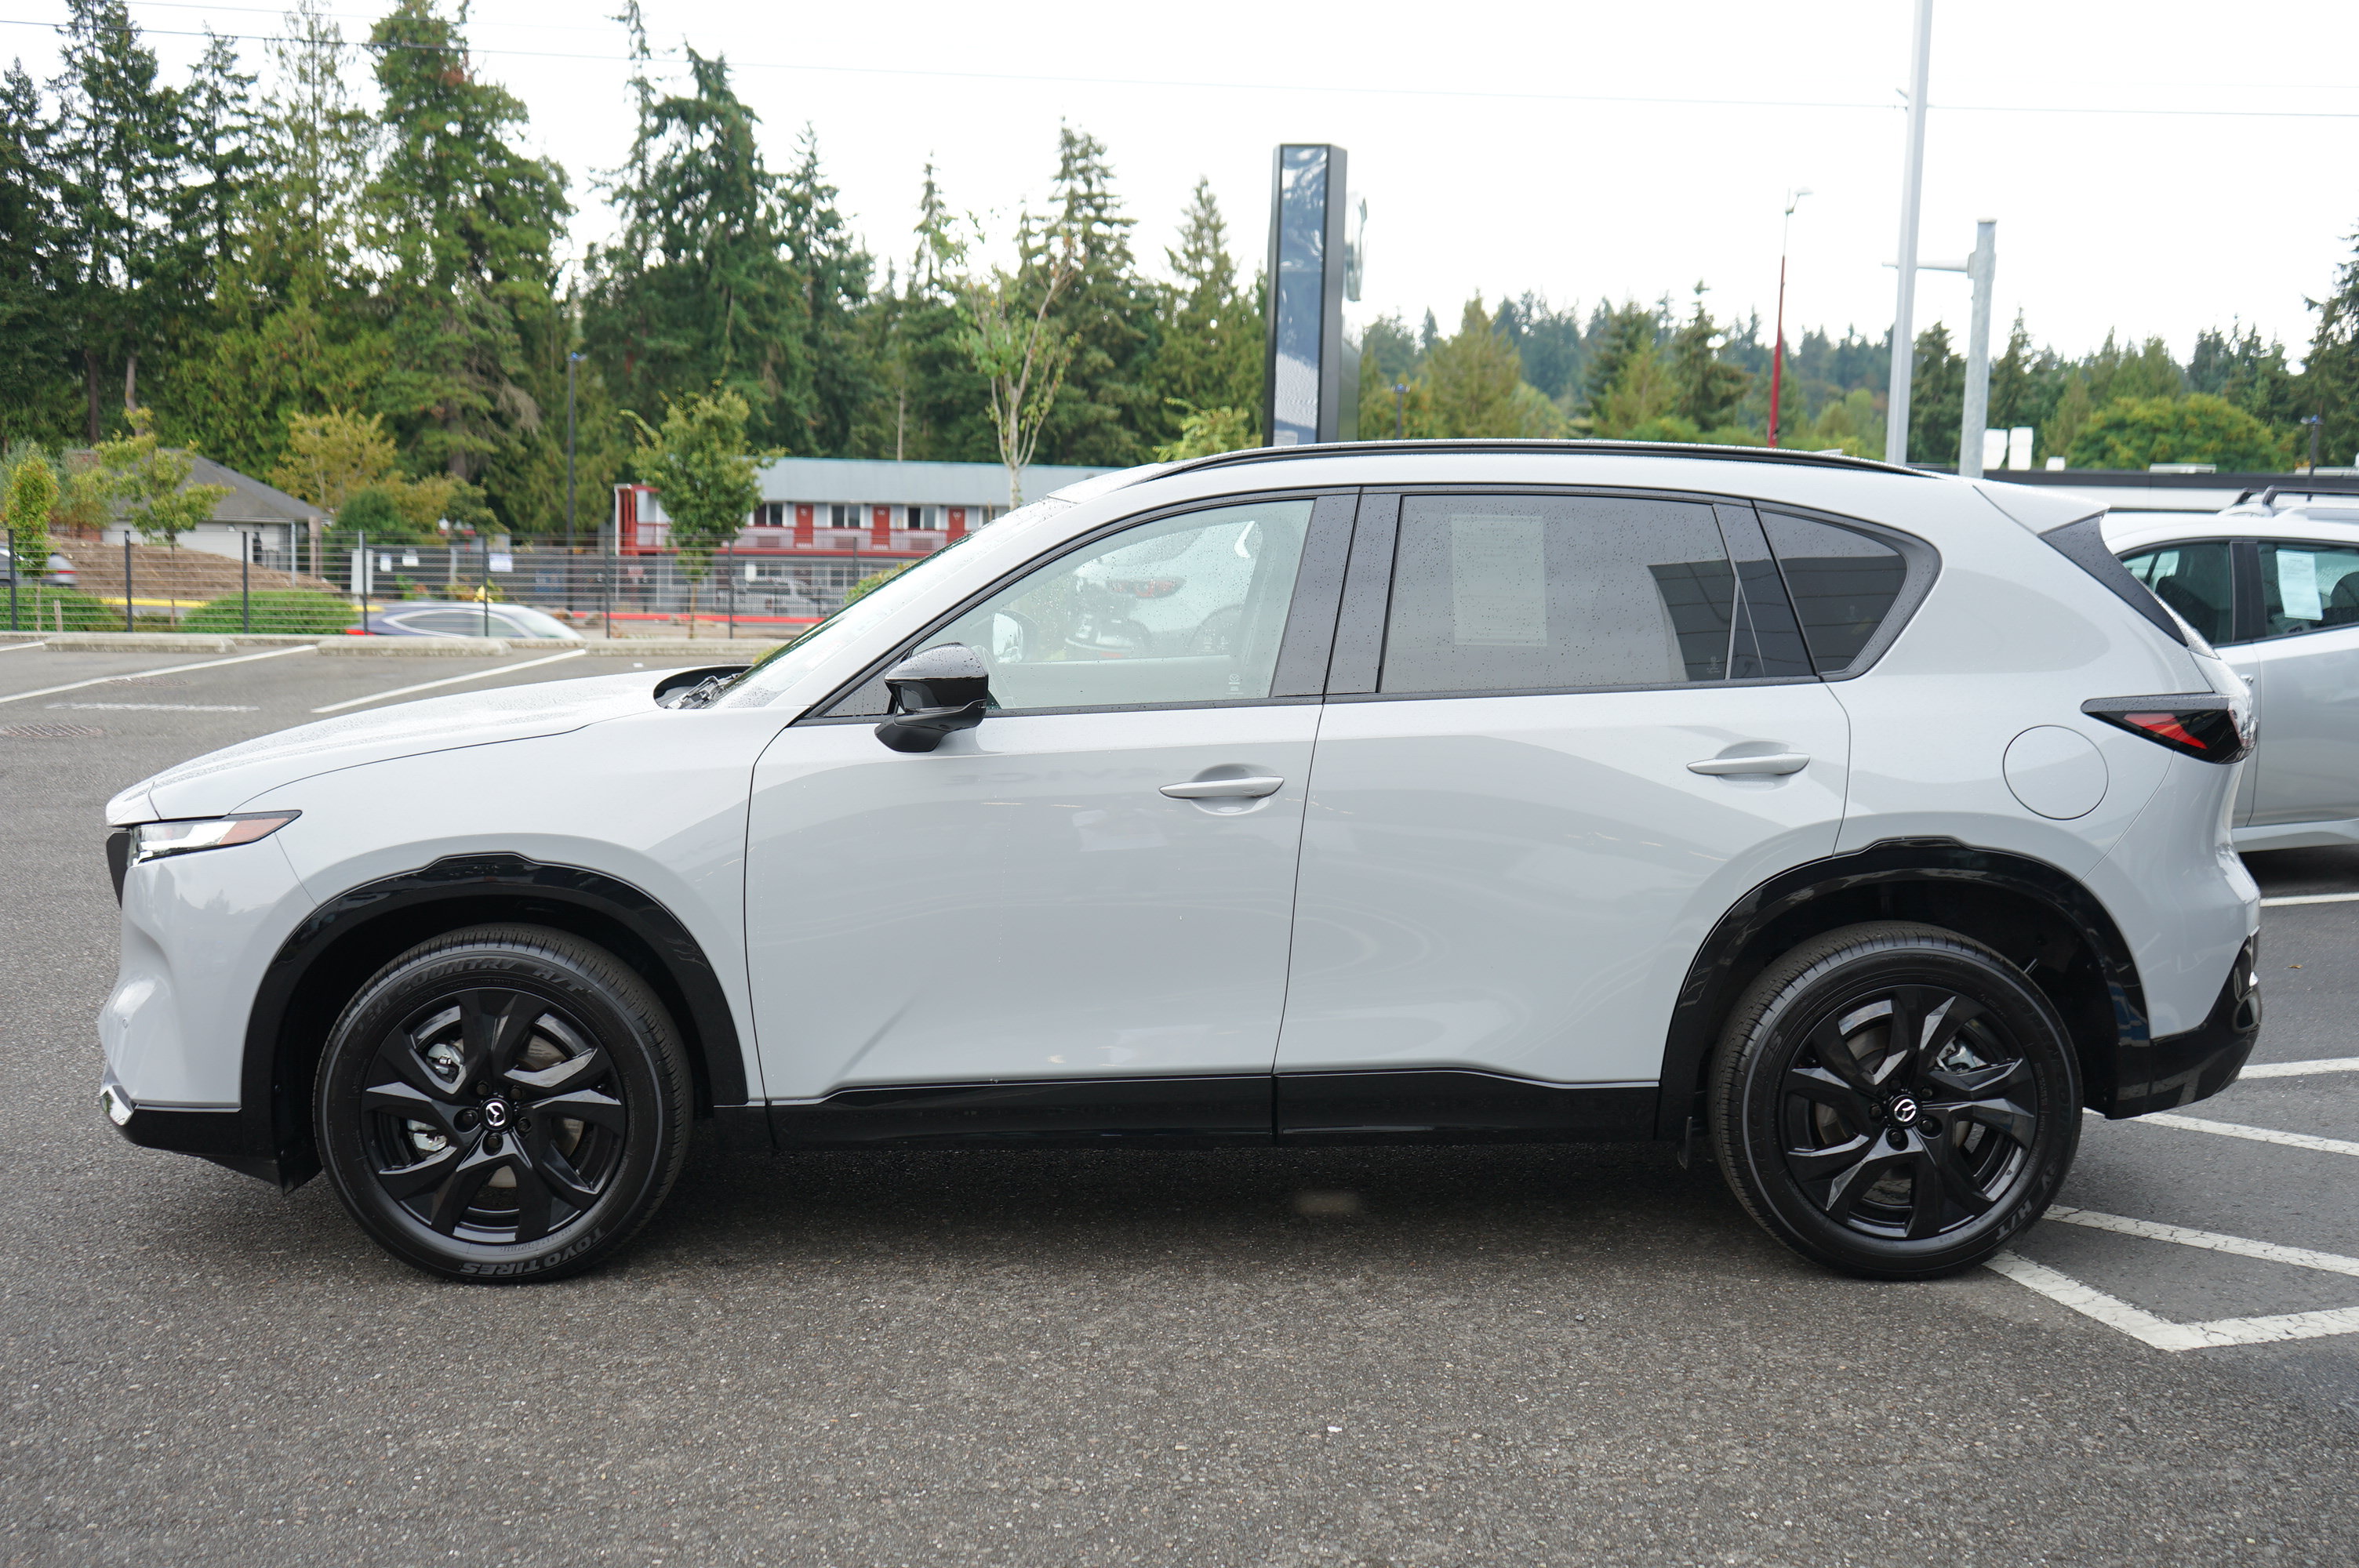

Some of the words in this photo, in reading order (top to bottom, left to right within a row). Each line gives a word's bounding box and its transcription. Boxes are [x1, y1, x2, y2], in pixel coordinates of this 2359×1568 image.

[398, 957, 518, 996] COUNTRY
[533, 966, 584, 992] H/T
[1996, 1200, 2033, 1240] H/T
[543, 1227, 607, 1268] TOYO
[460, 1259, 540, 1276] TIRES
